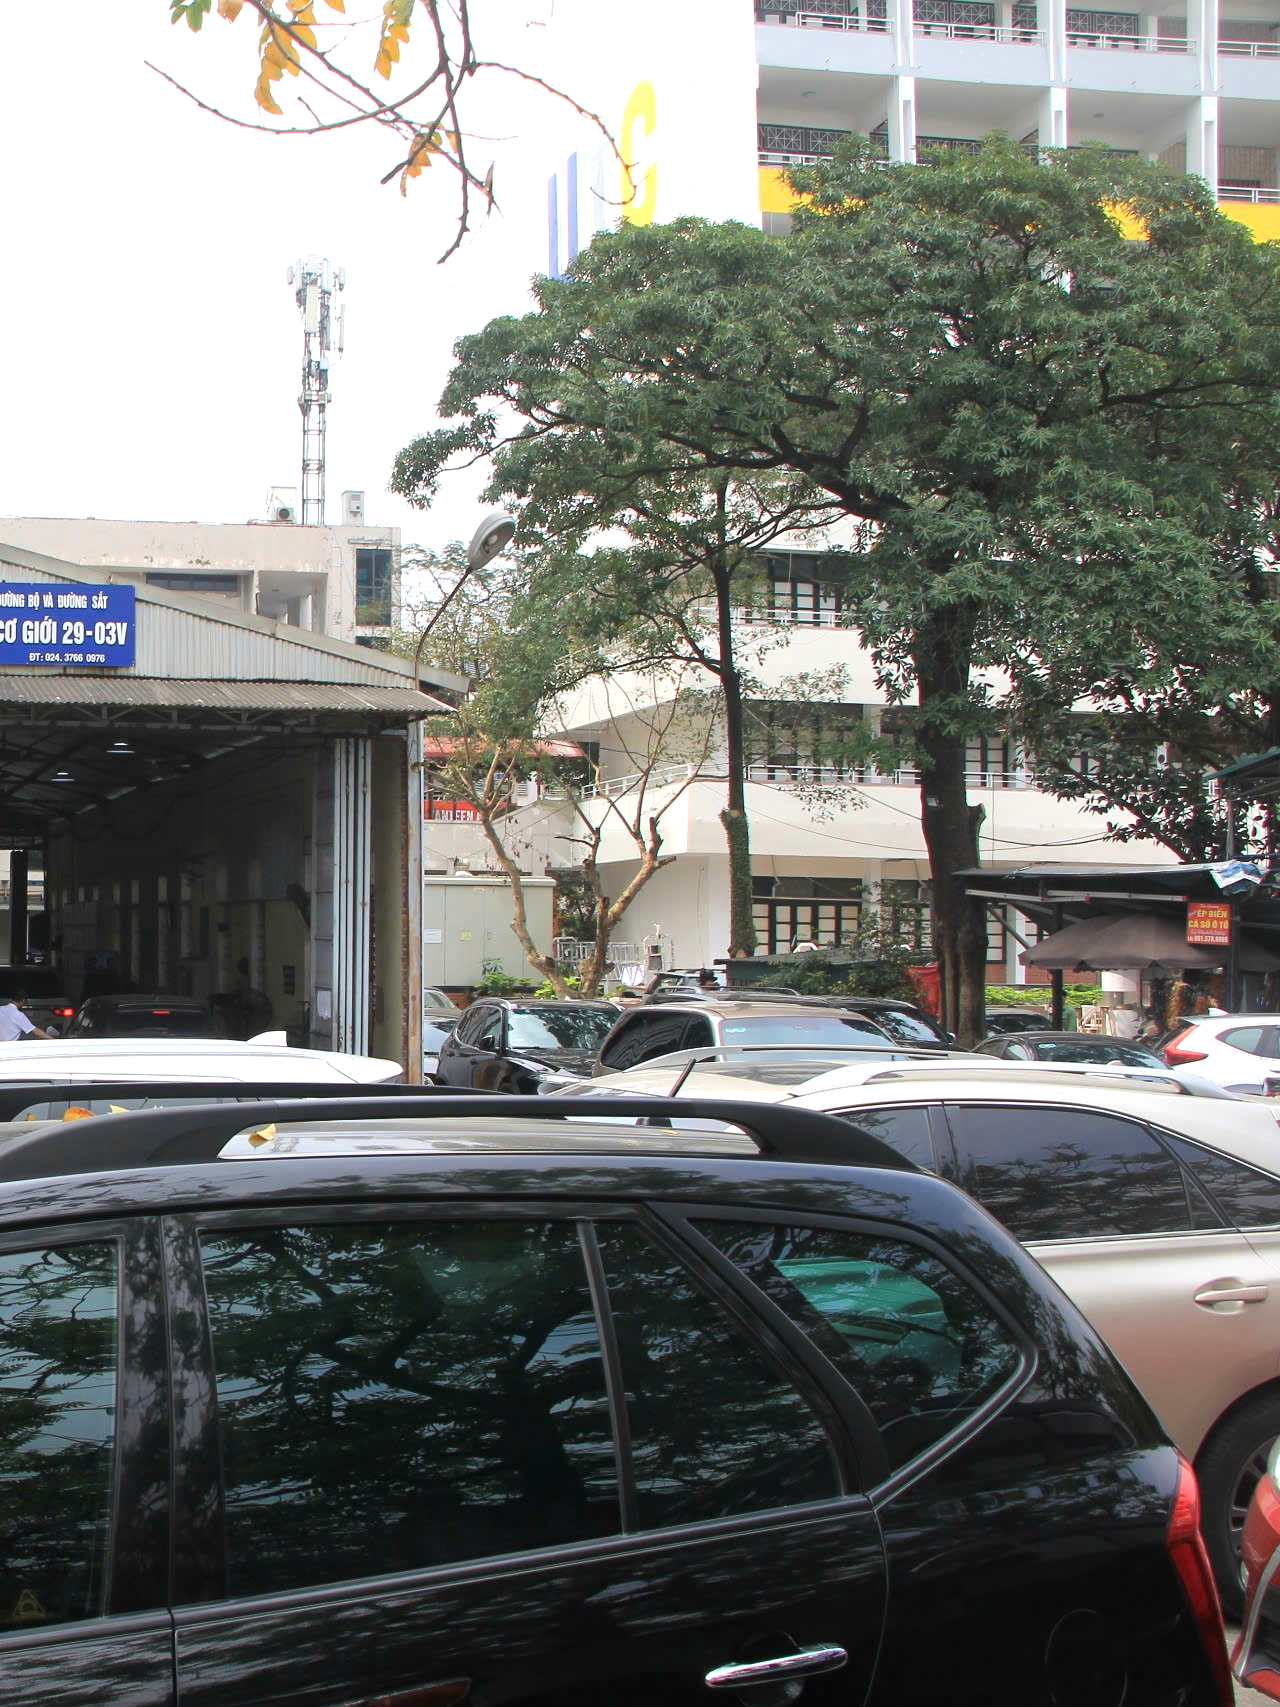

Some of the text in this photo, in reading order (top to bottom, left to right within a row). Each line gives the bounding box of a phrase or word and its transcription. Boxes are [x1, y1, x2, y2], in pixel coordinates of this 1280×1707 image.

[27, 592, 40, 610] BỘ
[43, 592, 54, 608] VÀ
[57, 592, 87, 609] ĐƯỜNG
[91, 591, 109, 609] SẮT
[22, 615, 57, 645] GIỚI
[61, 621, 128, 645] 29-03V
[29, 652, 106, 663] ĐT: 024. 3766 0976
[431, 809, 473, 820] ANTEEN
